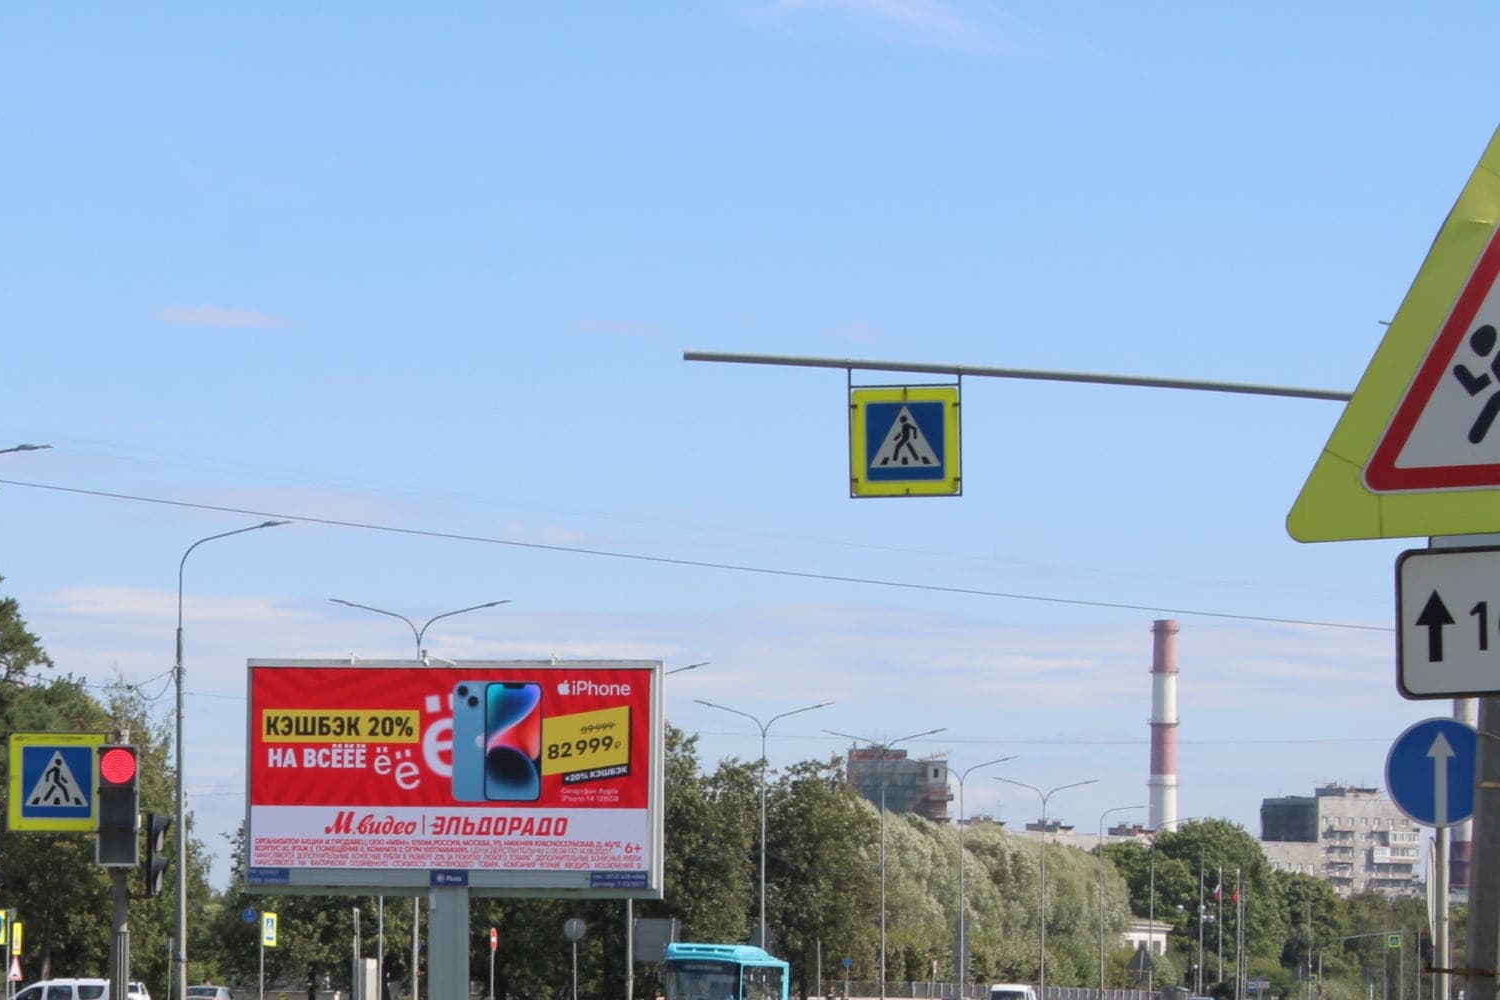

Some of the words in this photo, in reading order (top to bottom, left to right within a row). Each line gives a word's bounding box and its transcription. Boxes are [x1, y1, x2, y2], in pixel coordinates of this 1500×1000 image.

[1469, 601, 1500, 650] 1
[572, 680, 631, 696] iPhone
[266, 716, 360, 736] КЭШБЭК
[368, 716, 413, 737] 20%
[268, 748, 298, 768] НА
[589, 766, 628, 779] КЭШБЭК
[324, 810, 417, 836] М.видео
[428, 815, 568, 837] ЭЛЬДОРАДО
[624, 842, 642, 854] 6+
